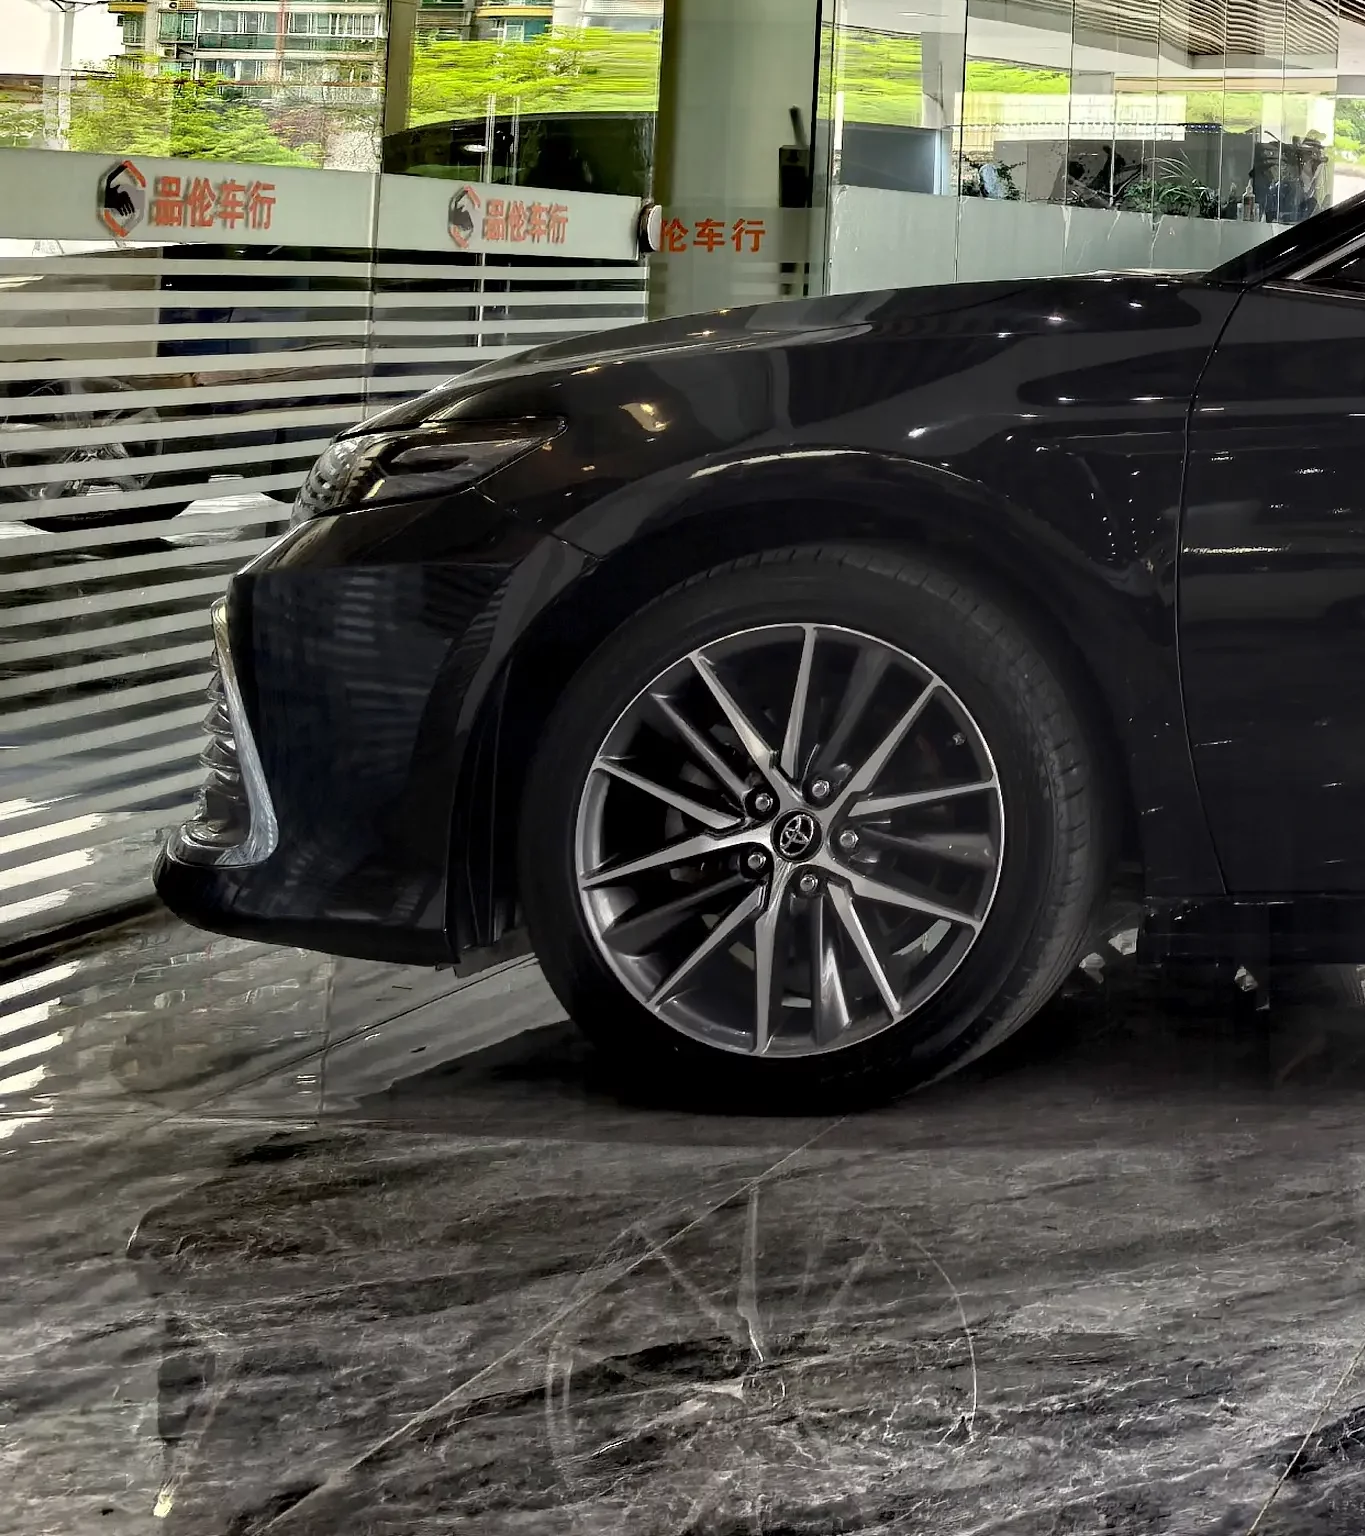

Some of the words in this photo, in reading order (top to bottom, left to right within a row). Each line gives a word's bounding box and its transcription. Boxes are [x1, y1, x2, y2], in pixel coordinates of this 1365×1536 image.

[152, 175, 276, 231] 品伦车行
[483, 199, 569, 244] 品伦车行
